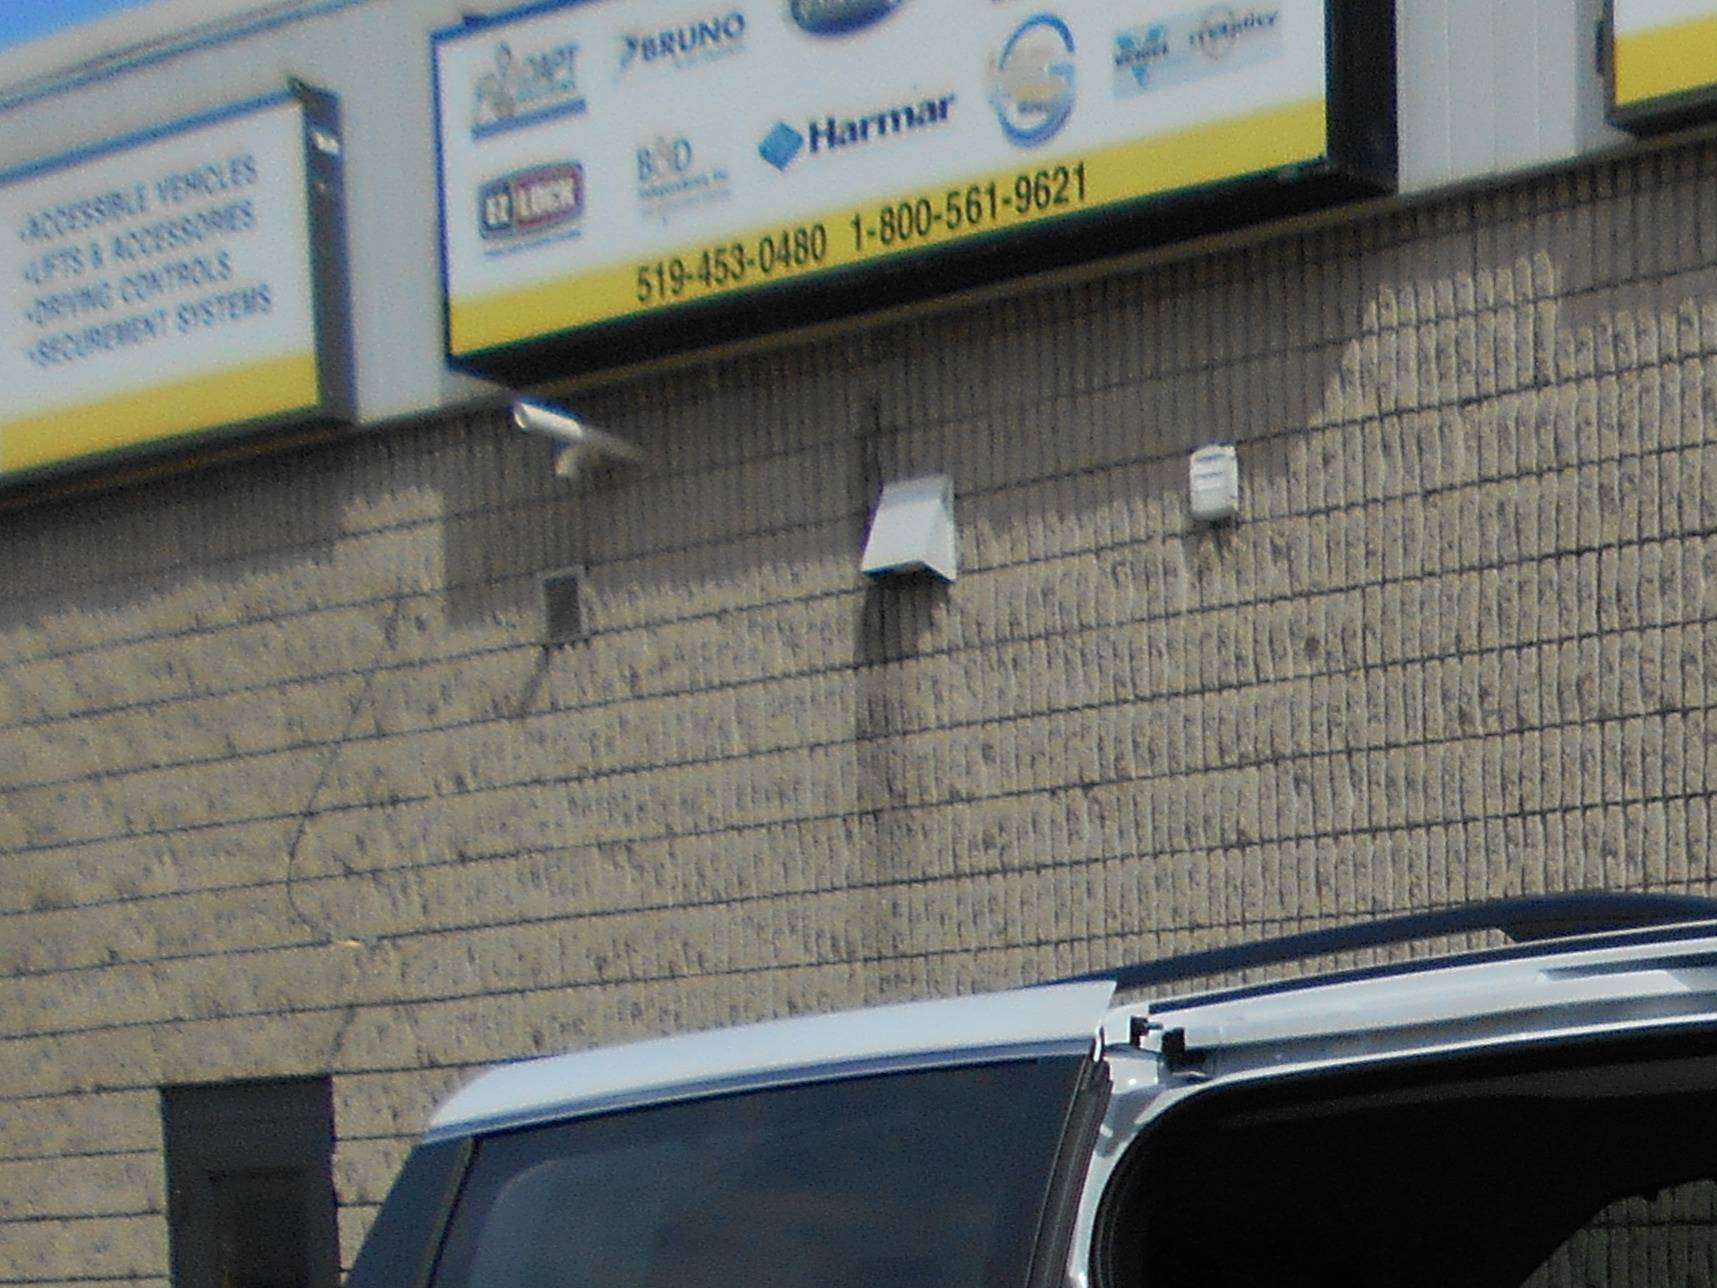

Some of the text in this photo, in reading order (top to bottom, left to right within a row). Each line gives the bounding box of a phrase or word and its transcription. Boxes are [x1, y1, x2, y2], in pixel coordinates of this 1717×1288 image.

[640, 10, 746, 64] BRUNO
[807, 93, 956, 154] Harmar
[636, 160, 1089, 303] 519-453-0480 1-800-561-9621
